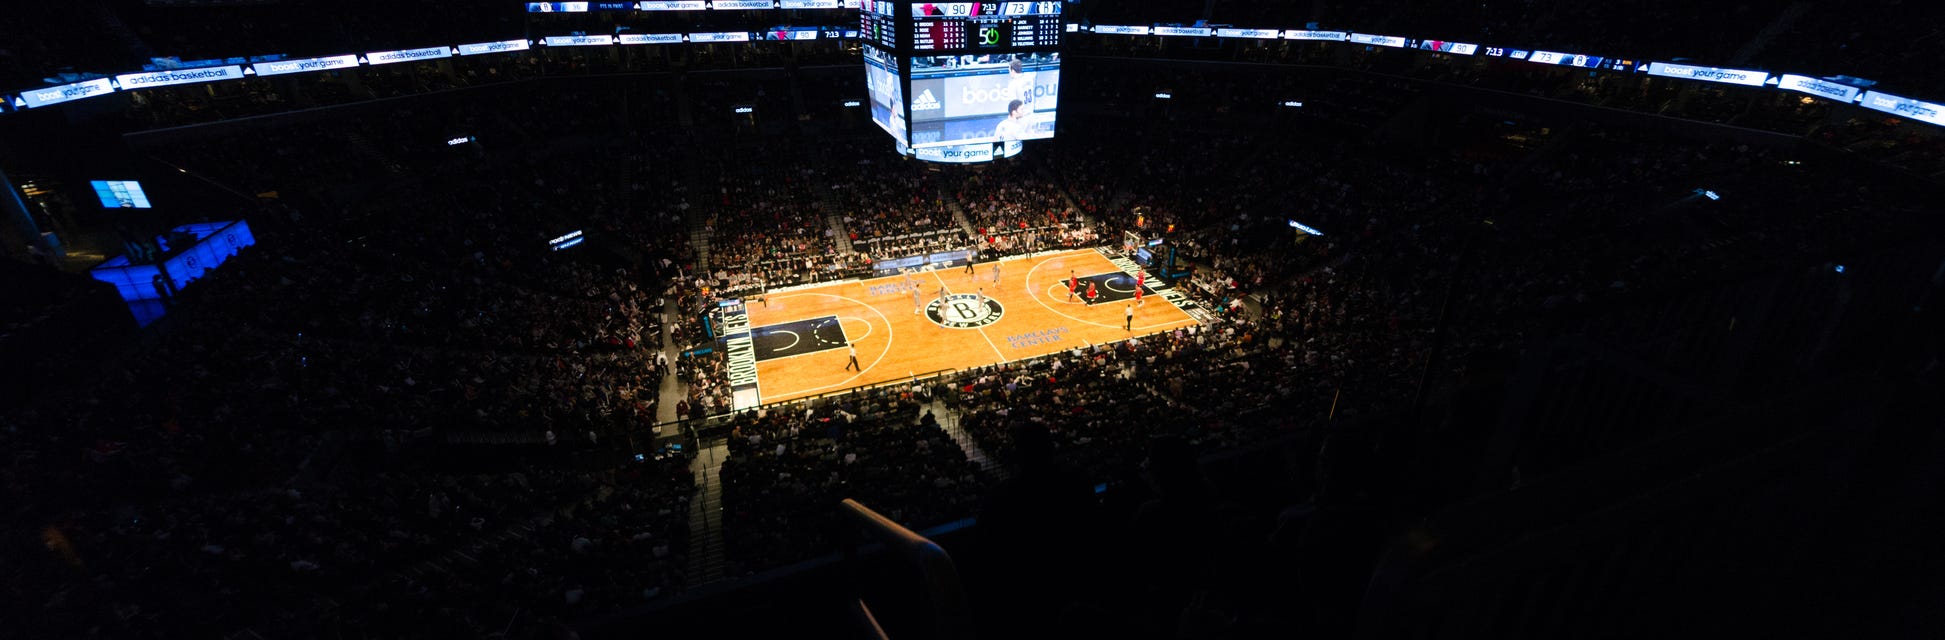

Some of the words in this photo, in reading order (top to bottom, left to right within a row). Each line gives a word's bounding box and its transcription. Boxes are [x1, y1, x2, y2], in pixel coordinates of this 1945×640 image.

[952, 4, 966, 14] 90
[982, 3, 997, 12] 7:13
[1013, 3, 1026, 14] 73
[825, 31, 840, 39] 7:13
[380, 52, 405, 61] adidas
[405, 47, 442, 58] basketball
[1456, 44, 1467, 53] 90
[1485, 47, 1504, 57] 7:13
[1541, 52, 1553, 62] 73
[270, 62, 300, 72] boost
[299, 61, 319, 71] your
[319, 58, 344, 69] game
[130, 73, 170, 85] adidas
[171, 69, 228, 82] basketball
[1663, 66, 1694, 77] boost
[1693, 69, 1714, 79] your
[1714, 70, 1748, 82] game
[911, 101, 941, 111] adidas
[943, 149, 964, 159] your
[965, 148, 991, 159] game
[1155, 287, 1194, 308] NETS
[952, 302, 977, 320] B
[723, 313, 750, 337] NETS
[1007, 326, 1069, 343] BARCLAYS
[1011, 335, 1062, 349] CENTER
[726, 337, 757, 387] BROOKLYN
